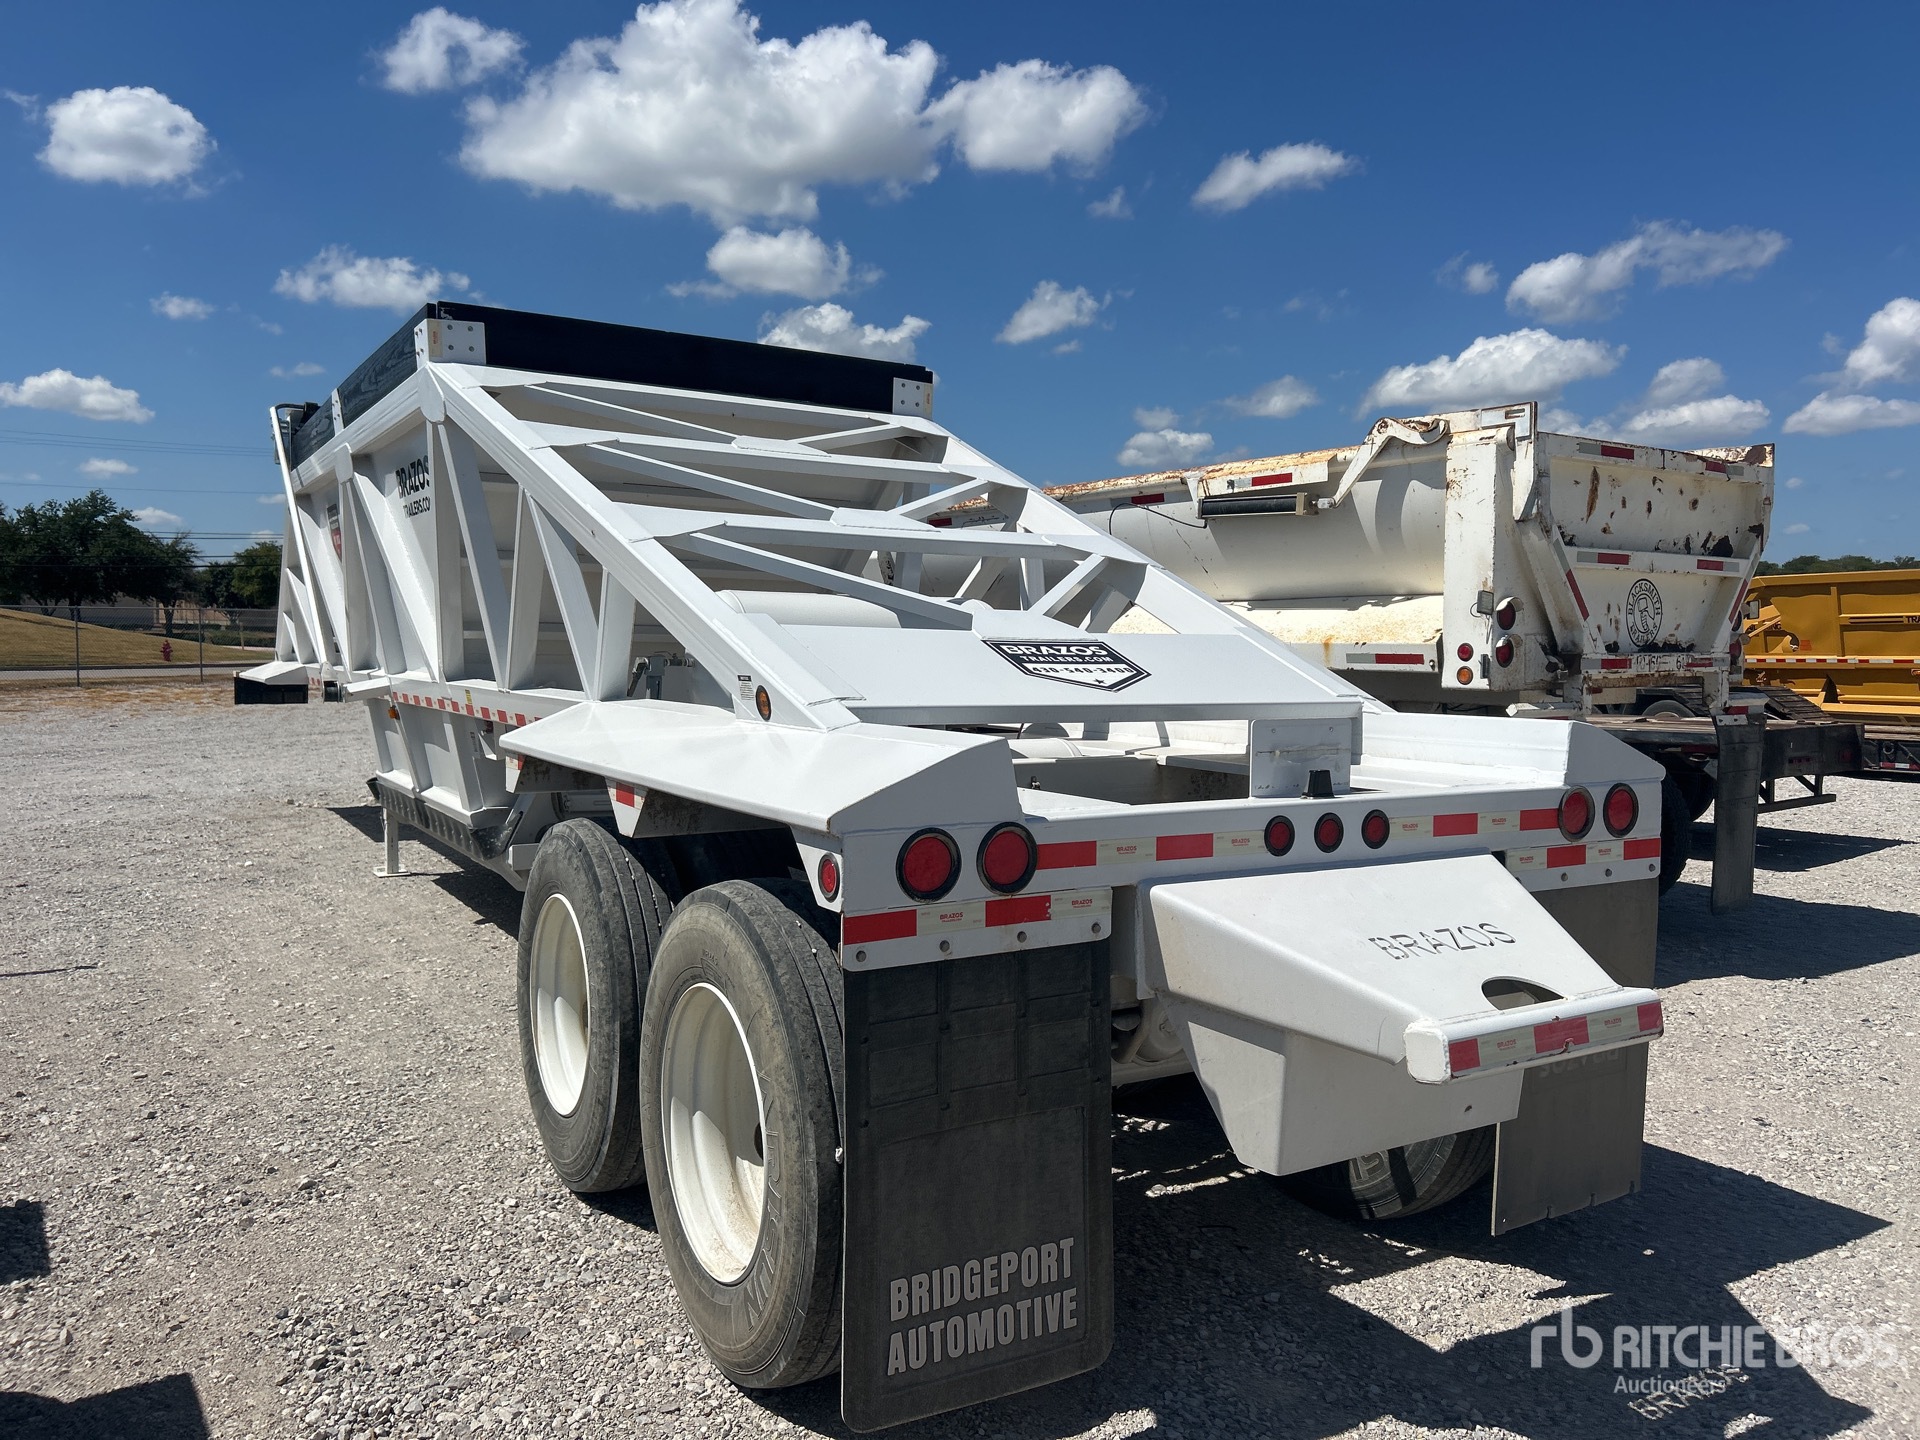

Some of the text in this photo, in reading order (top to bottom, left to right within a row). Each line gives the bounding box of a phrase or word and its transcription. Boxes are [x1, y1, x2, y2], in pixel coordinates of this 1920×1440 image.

[1628, 582, 1661, 616] BLACKSMITH
[999, 644, 1108, 656] BRAZOS
[1019, 655, 1114, 663] TRAILERS.COM
[1071, 898, 1093, 906] BRAZOS
[939, 911, 964, 920] BRAZOS
[1367, 922, 1517, 960] BRAZOS
[890, 1237, 1075, 1322] BRIDGEPORT
[887, 1287, 1078, 1376] AUTOMOTIVE
